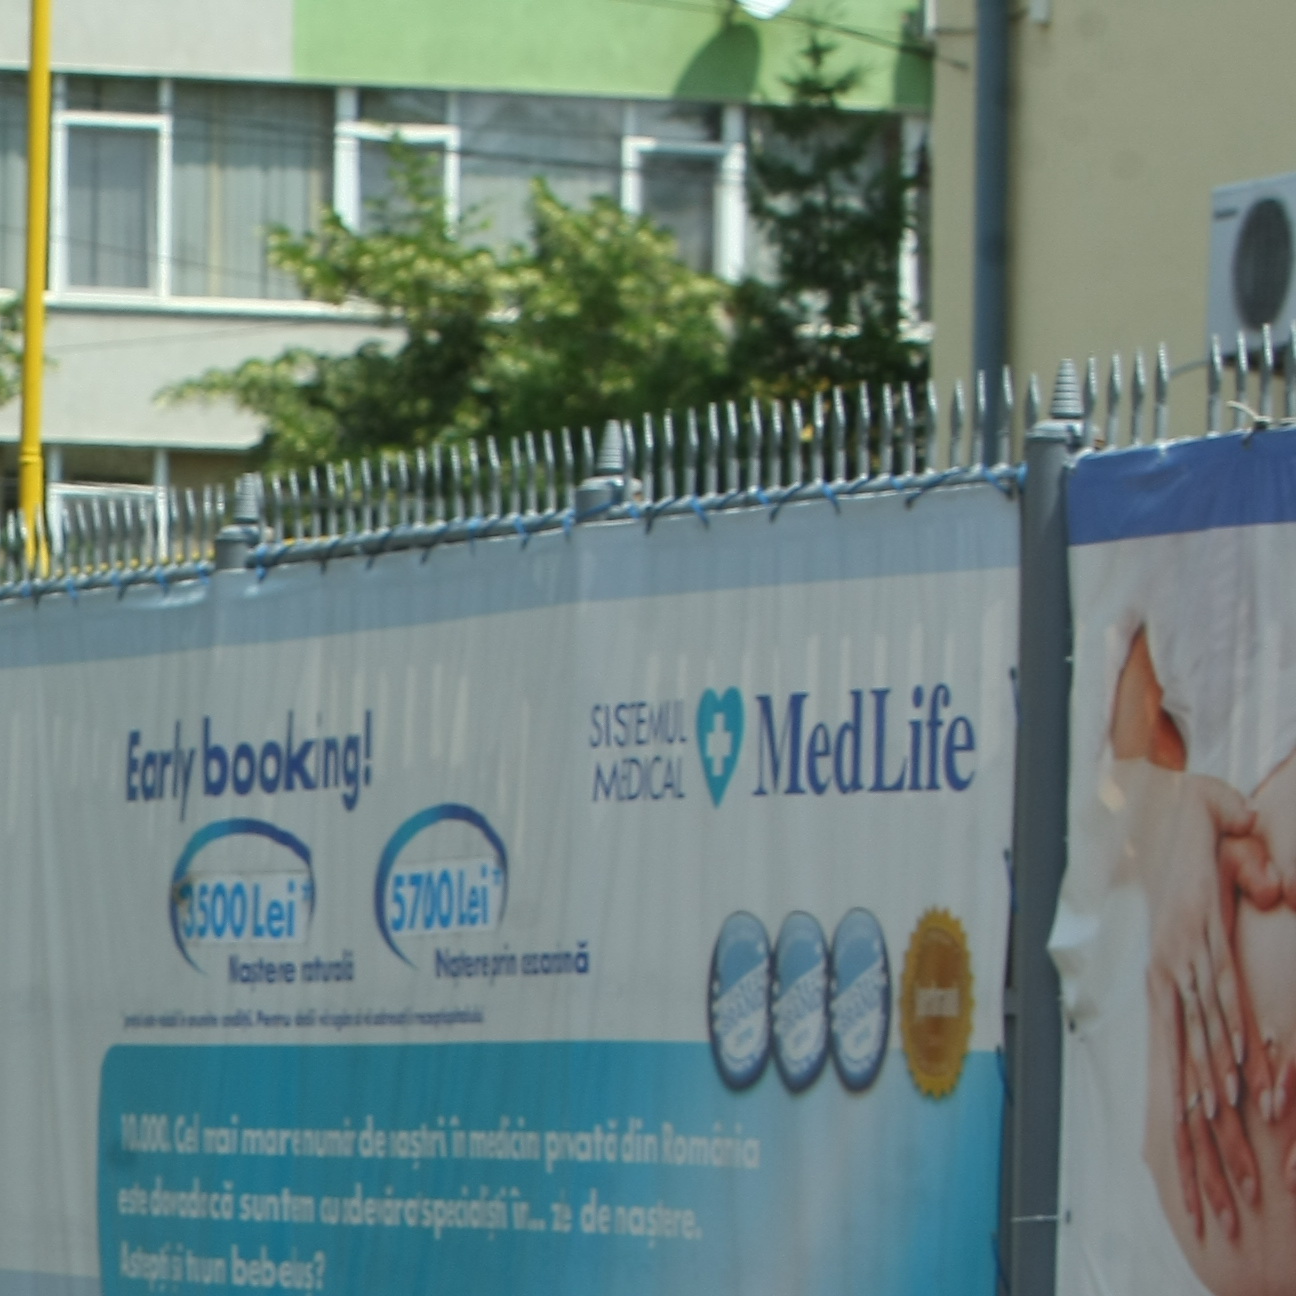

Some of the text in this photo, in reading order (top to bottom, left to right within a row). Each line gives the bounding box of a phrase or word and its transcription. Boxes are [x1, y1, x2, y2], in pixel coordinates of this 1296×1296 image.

[589, 700, 688, 747] SISTEMUL
[751, 682, 976, 797] MedLife
[126, 708, 373, 823] Early booking!
[391, 869, 454, 931] 5700
[359, 1114, 385, 1157] de
[621, 1117, 658, 1163] din
[580, 1187, 611, 1234] de
